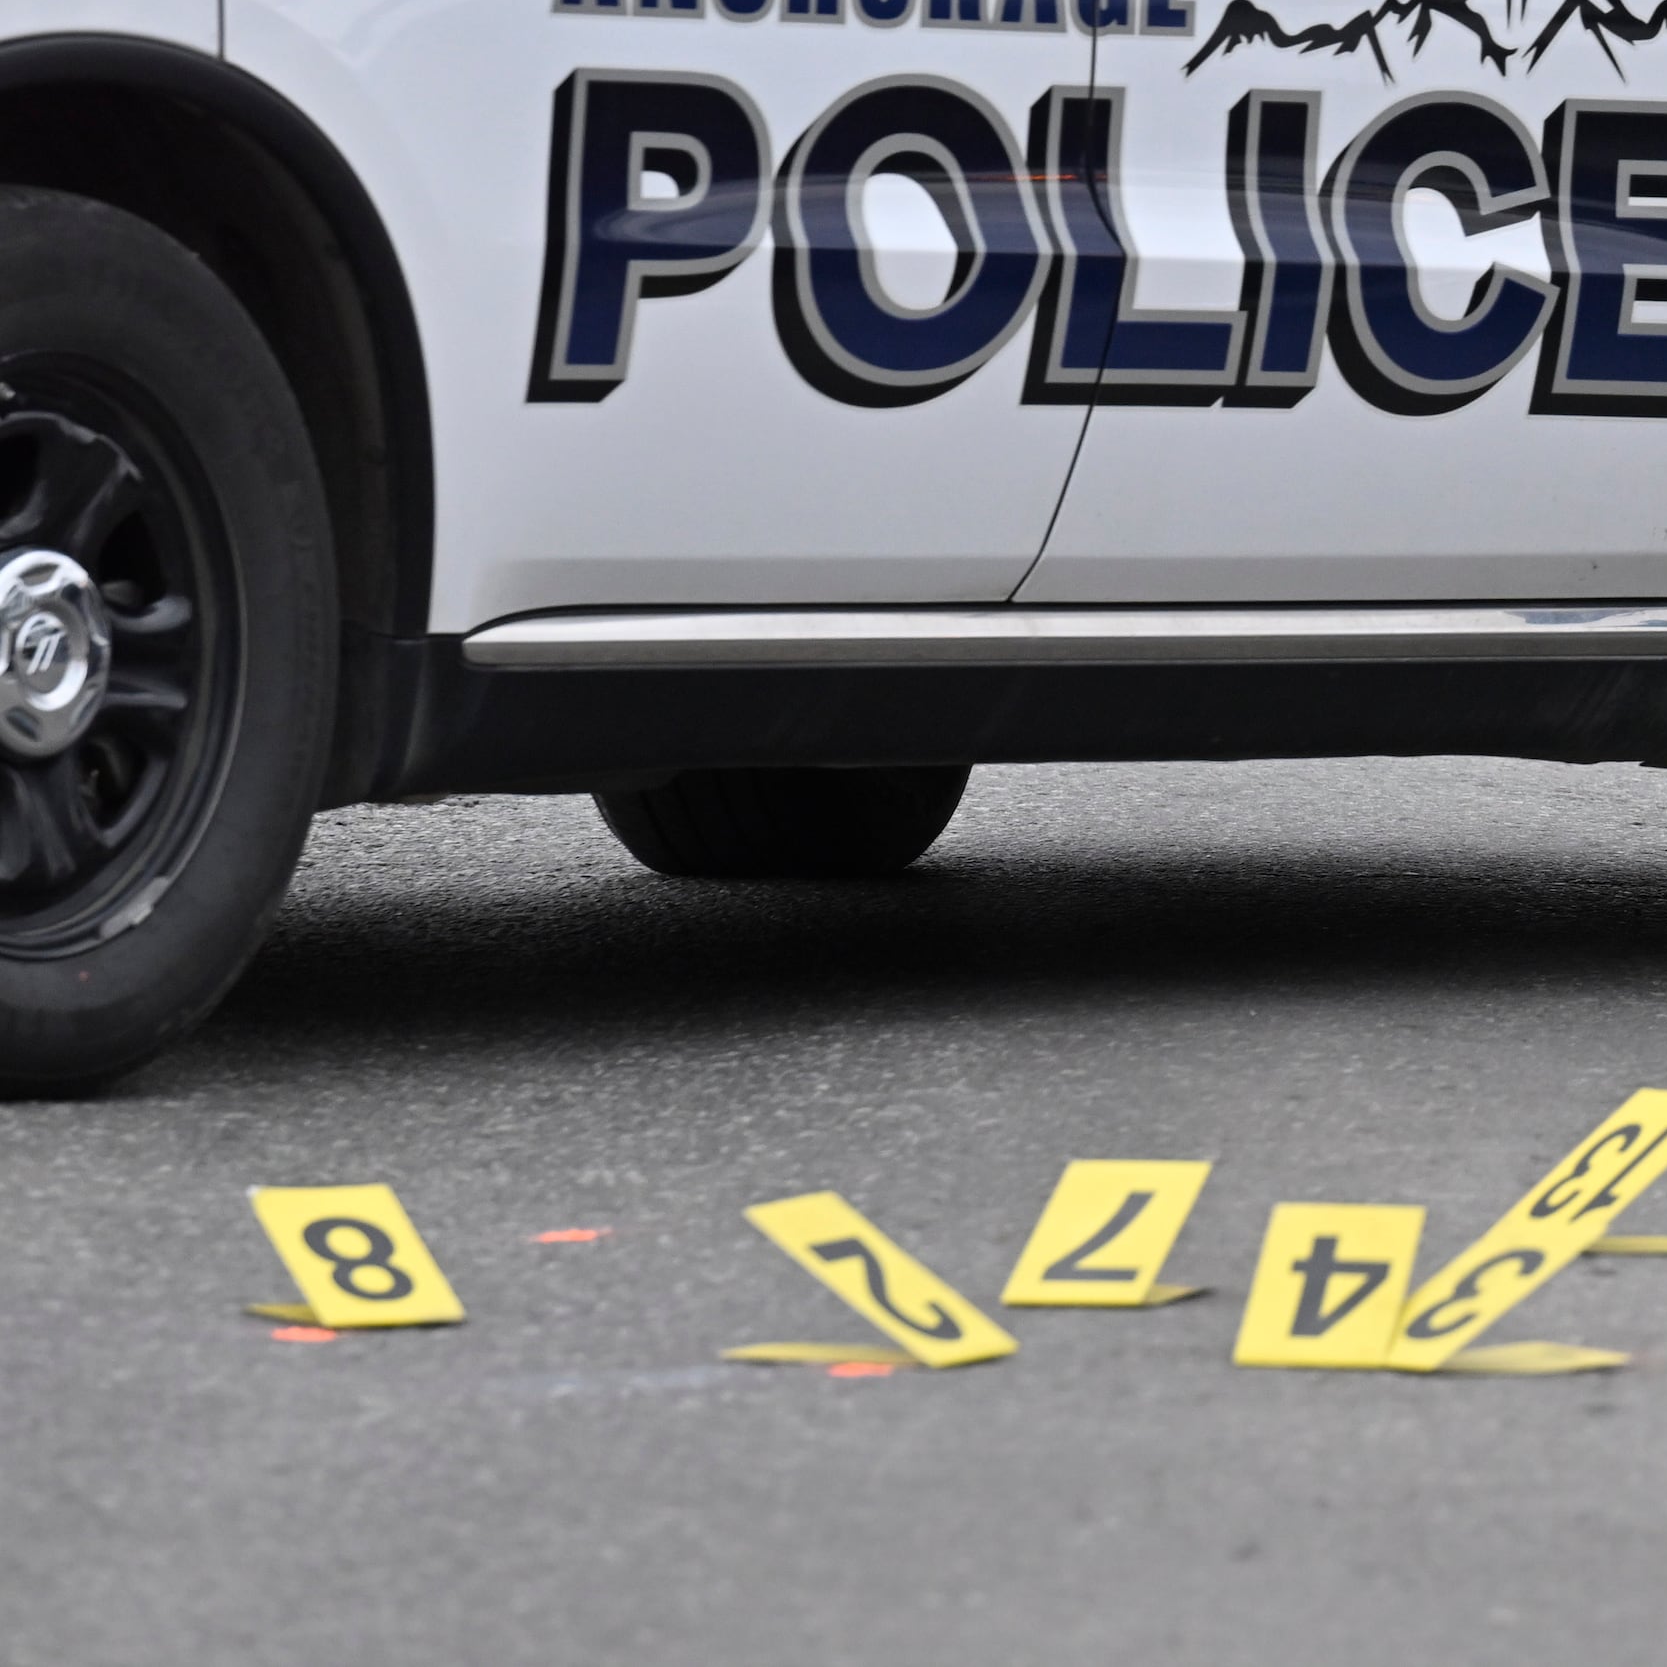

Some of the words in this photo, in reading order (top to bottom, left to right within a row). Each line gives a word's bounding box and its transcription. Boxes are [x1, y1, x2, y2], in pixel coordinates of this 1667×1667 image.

[302, 1217, 414, 1302] 8
[1041, 1191, 1155, 1281] 7
[808, 1236, 964, 1341] 2
[1289, 1235, 1391, 1337] 4
[1405, 1248, 1546, 1340] 3
